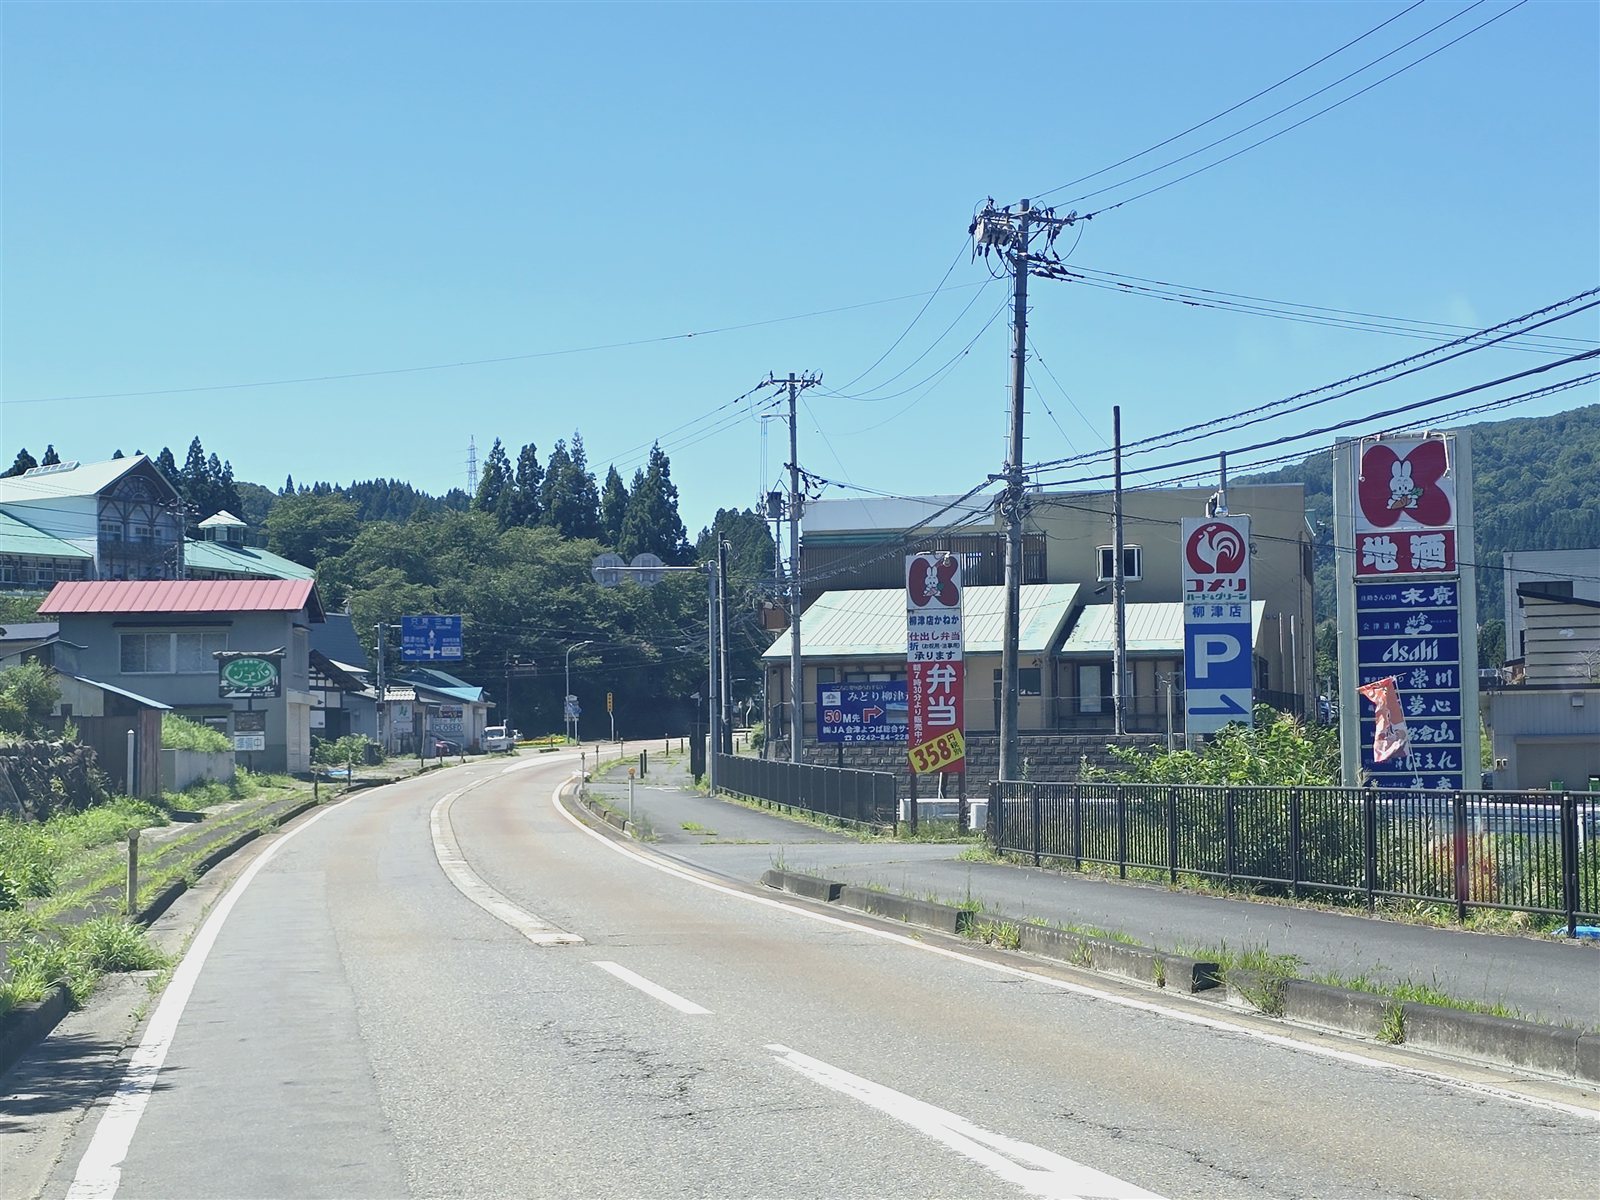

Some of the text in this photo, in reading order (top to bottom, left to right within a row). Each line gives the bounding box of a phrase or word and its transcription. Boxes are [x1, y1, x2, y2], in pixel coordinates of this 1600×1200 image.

[1362, 533, 1446, 571] 地酒
[1186, 578, 1247, 592] コメリ
[1400, 585, 1454, 605] 末廣
[1192, 605, 1242, 618] 柳津店
[909, 631, 960, 641] 仕出し弁当
[909, 641, 919, 651] 折
[914, 651, 956, 661] 承ります
[1194, 633, 1241, 679] P
[1382, 639, 1438, 662] Asahi
[926, 663, 957, 726] 弁当
[914, 738, 952, 771] 358
